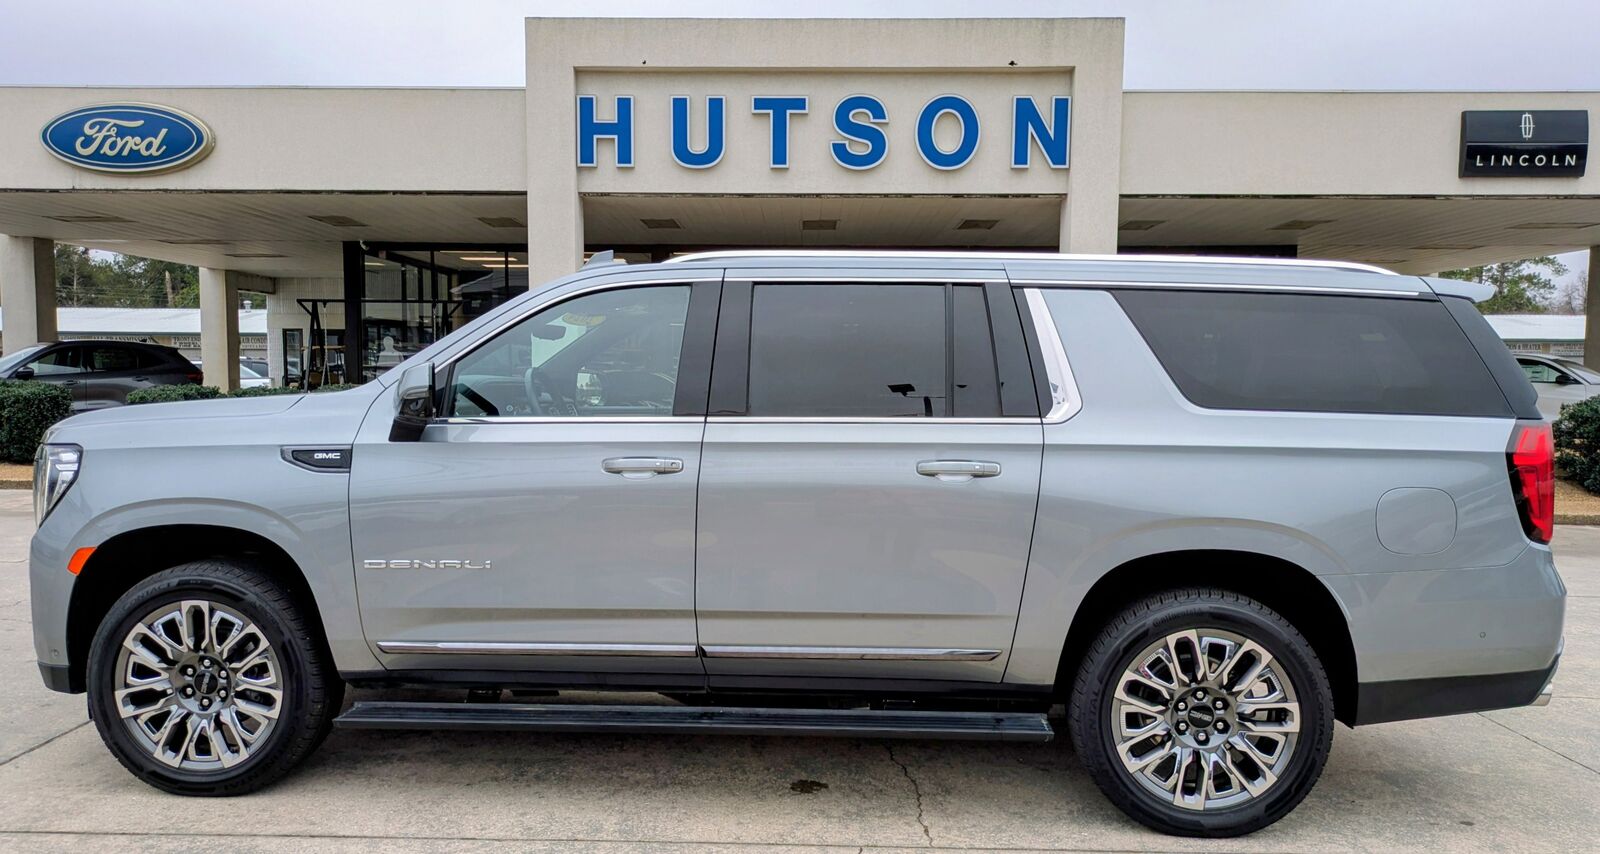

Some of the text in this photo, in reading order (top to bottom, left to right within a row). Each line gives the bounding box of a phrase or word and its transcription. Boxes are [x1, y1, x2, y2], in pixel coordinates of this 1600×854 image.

[75, 117, 169, 157] Ford
[576, 94, 1072, 170] HUTSON
[1476, 154, 1577, 167] LINCOLN
[363, 559, 492, 570] DENALI
